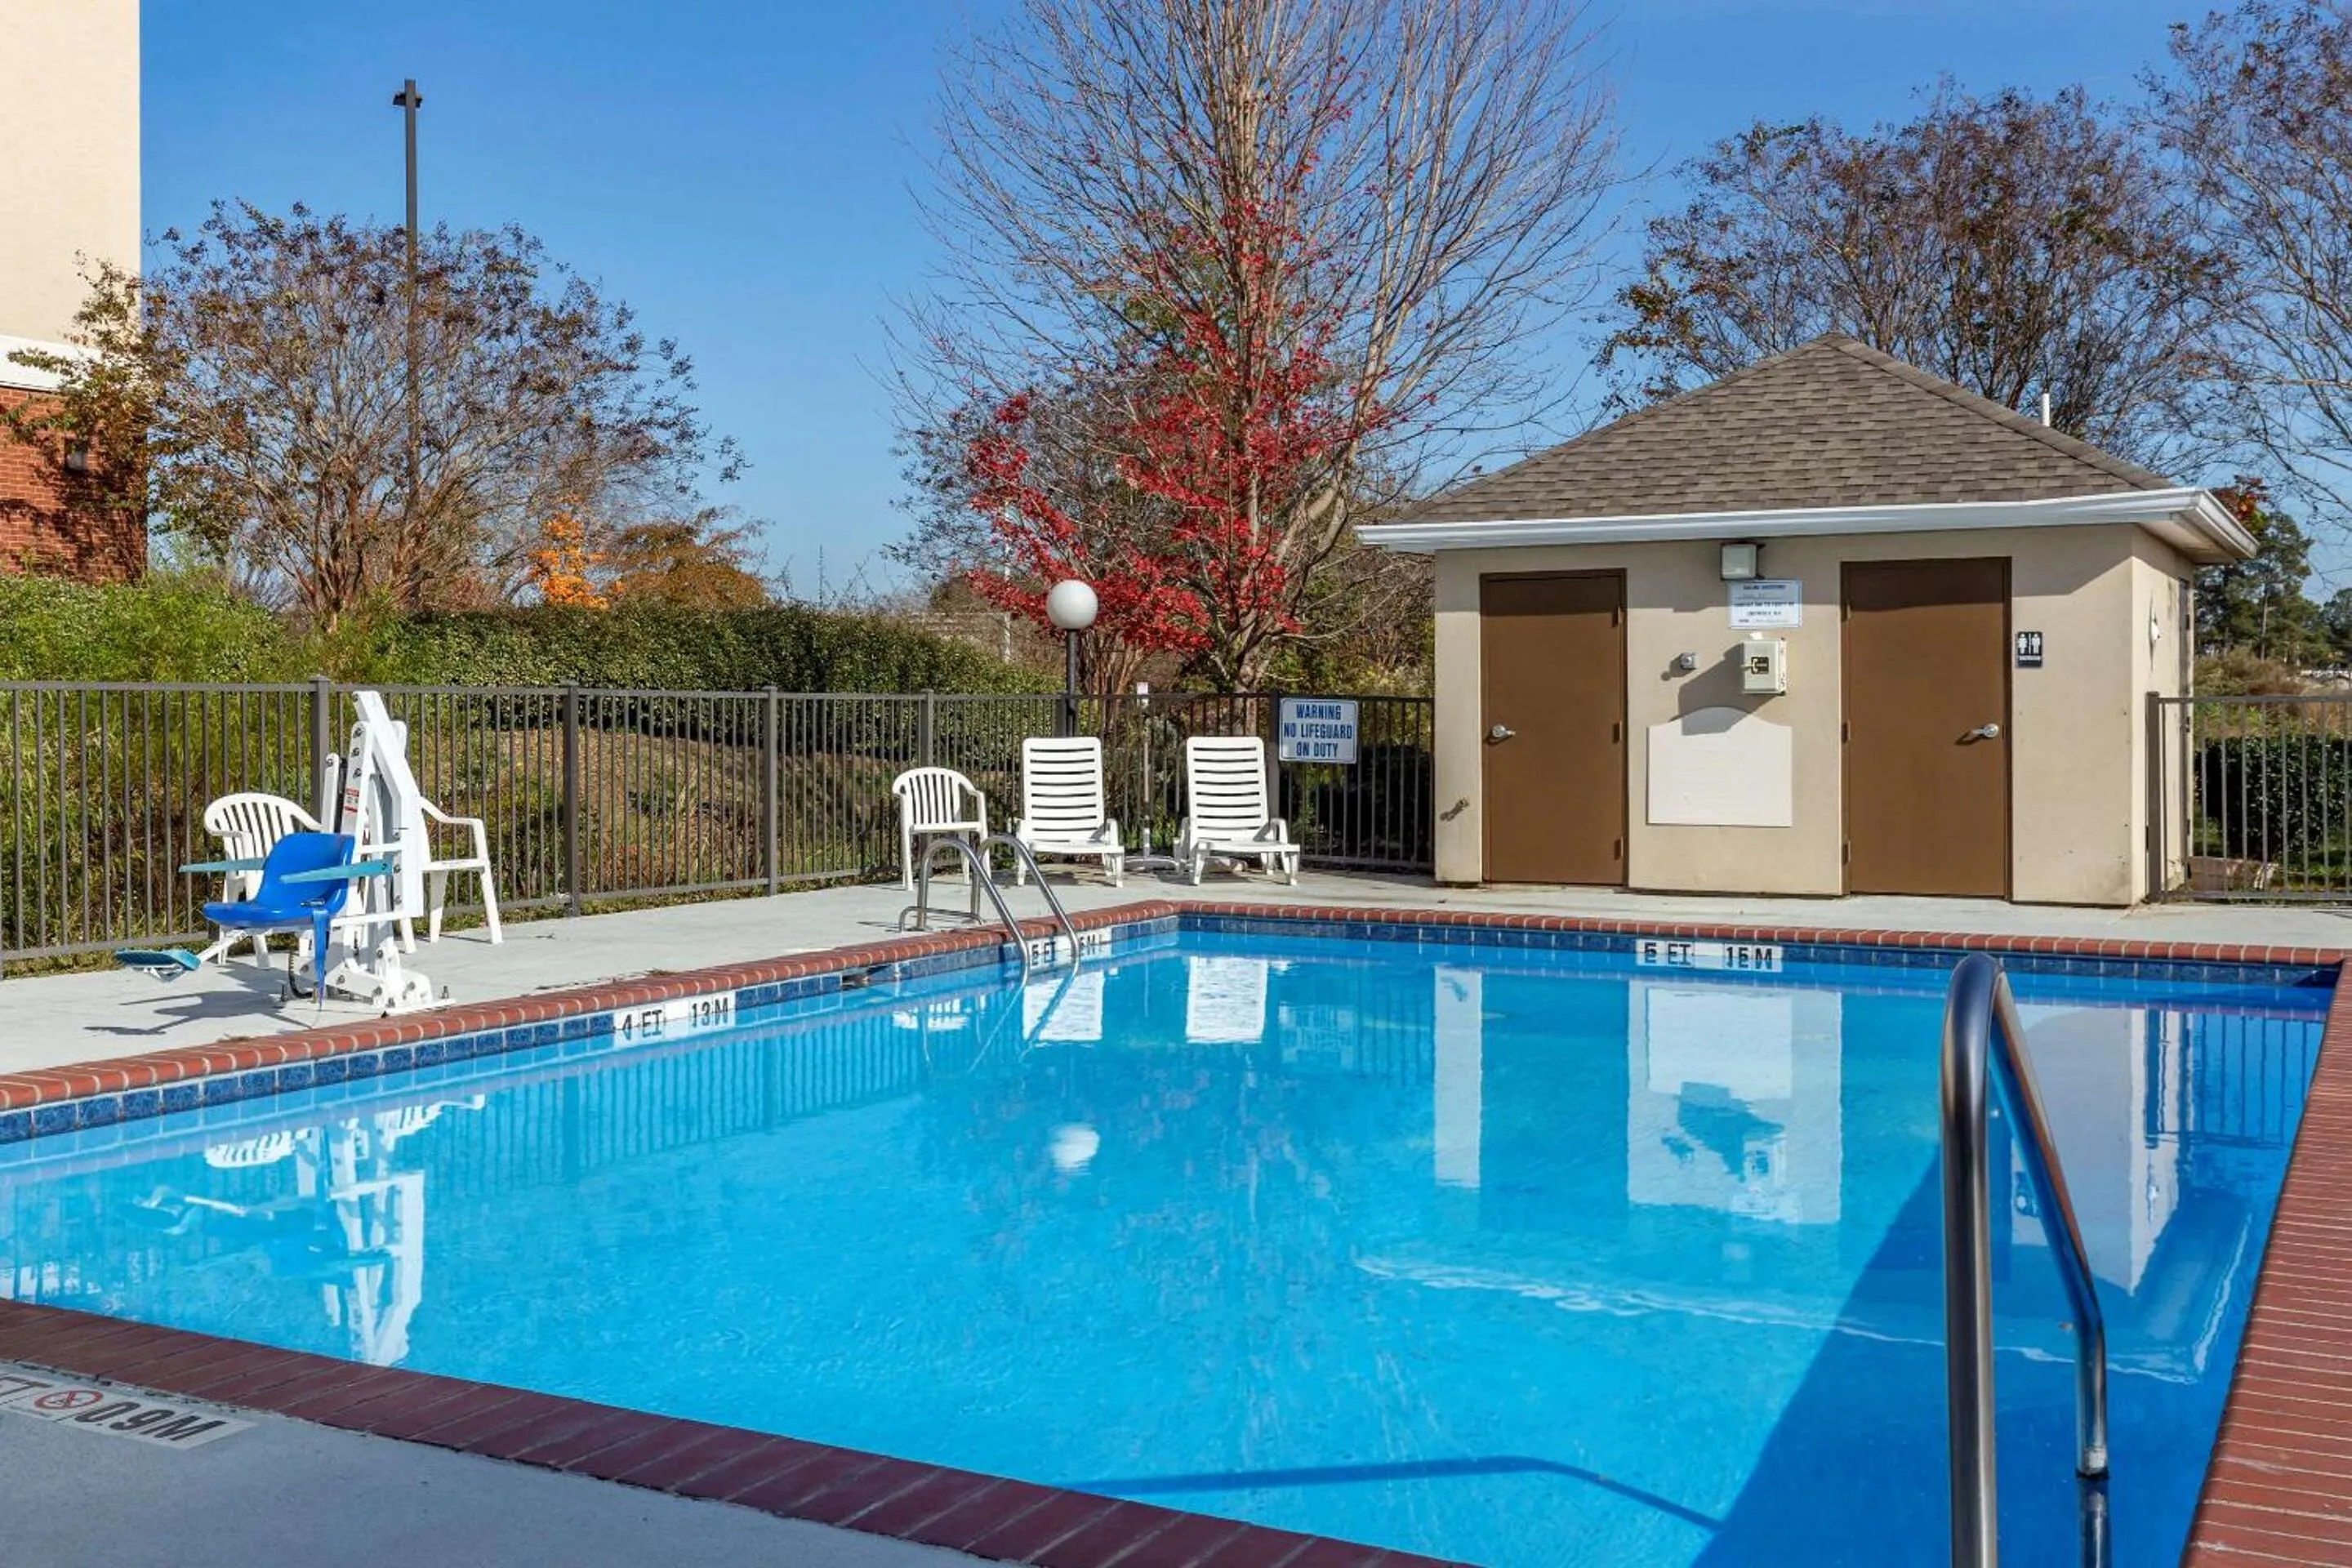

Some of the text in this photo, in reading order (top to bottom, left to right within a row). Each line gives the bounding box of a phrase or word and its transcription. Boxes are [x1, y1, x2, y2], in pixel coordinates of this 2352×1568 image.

[1296, 703, 1342, 720] WARNING
[1283, 722, 1352, 739] NO LIFEGUARD
[1296, 741, 1338, 758] ON DUTY
